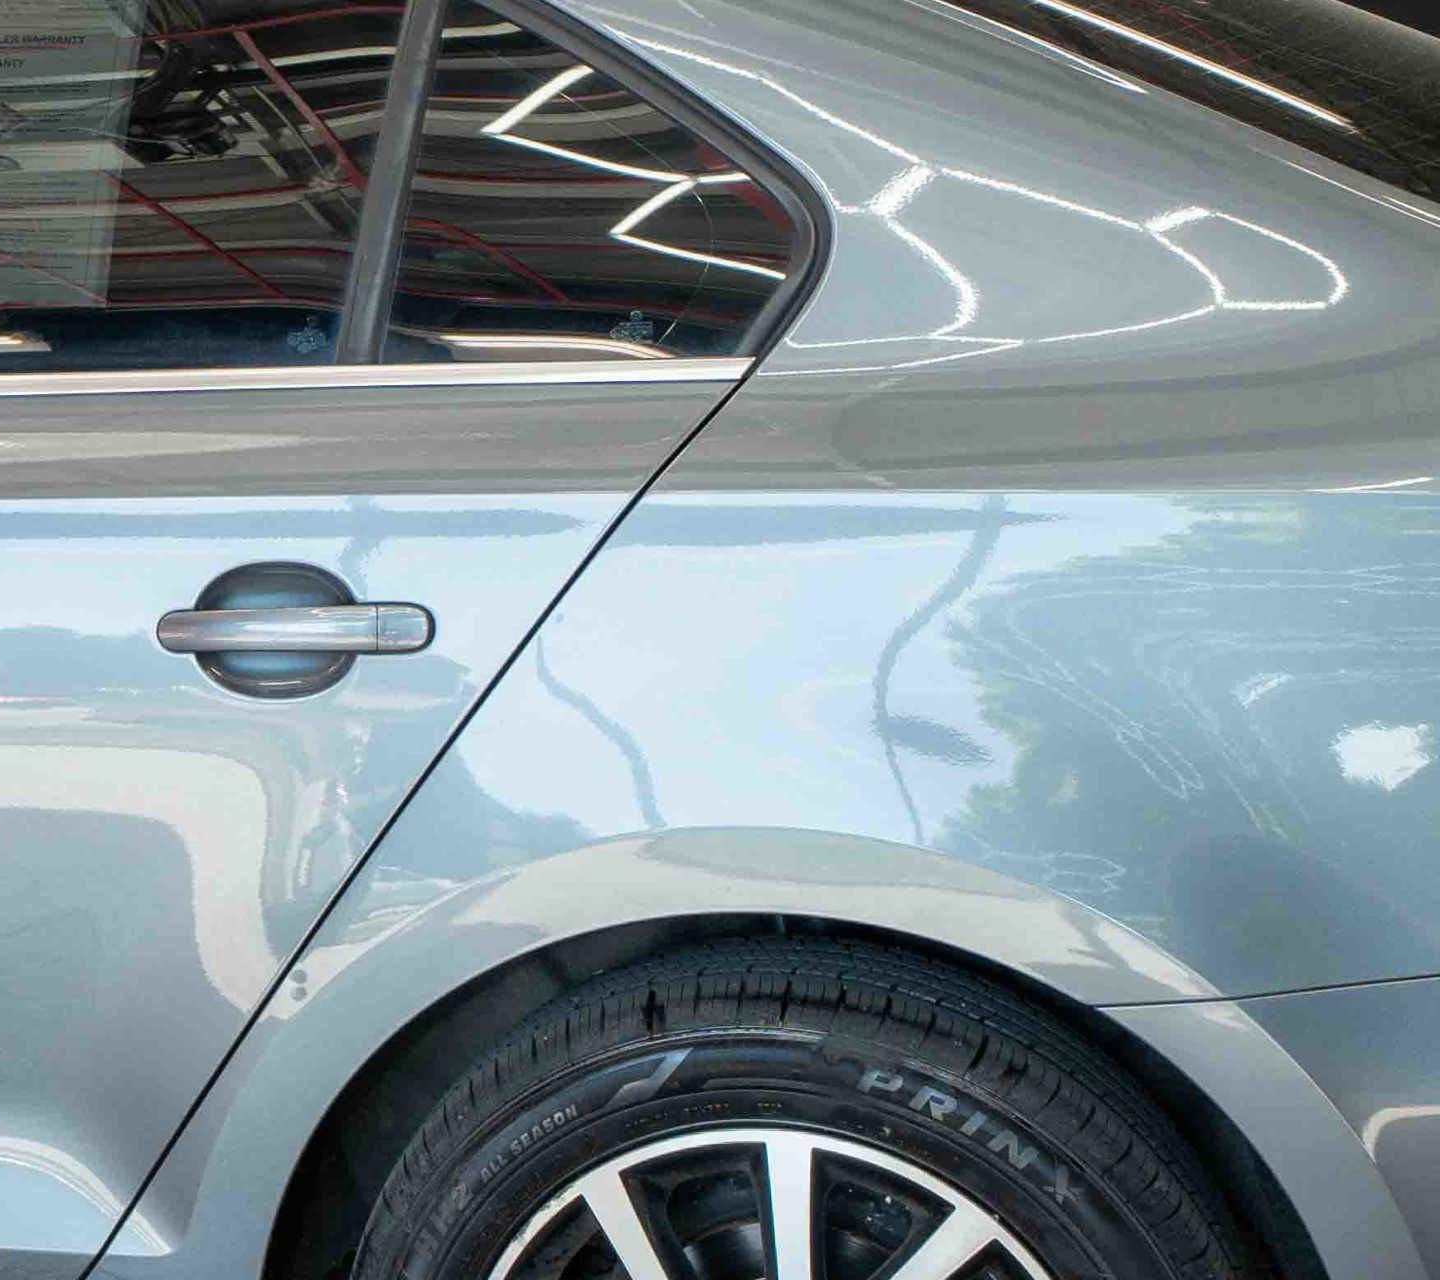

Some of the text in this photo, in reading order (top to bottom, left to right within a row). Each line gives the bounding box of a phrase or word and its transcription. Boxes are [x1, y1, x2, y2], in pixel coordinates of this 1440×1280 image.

[480, 1153, 510, 1184] ALL
[509, 1103, 579, 1156] SEASON
[858, 1068, 1080, 1206] PRINX
